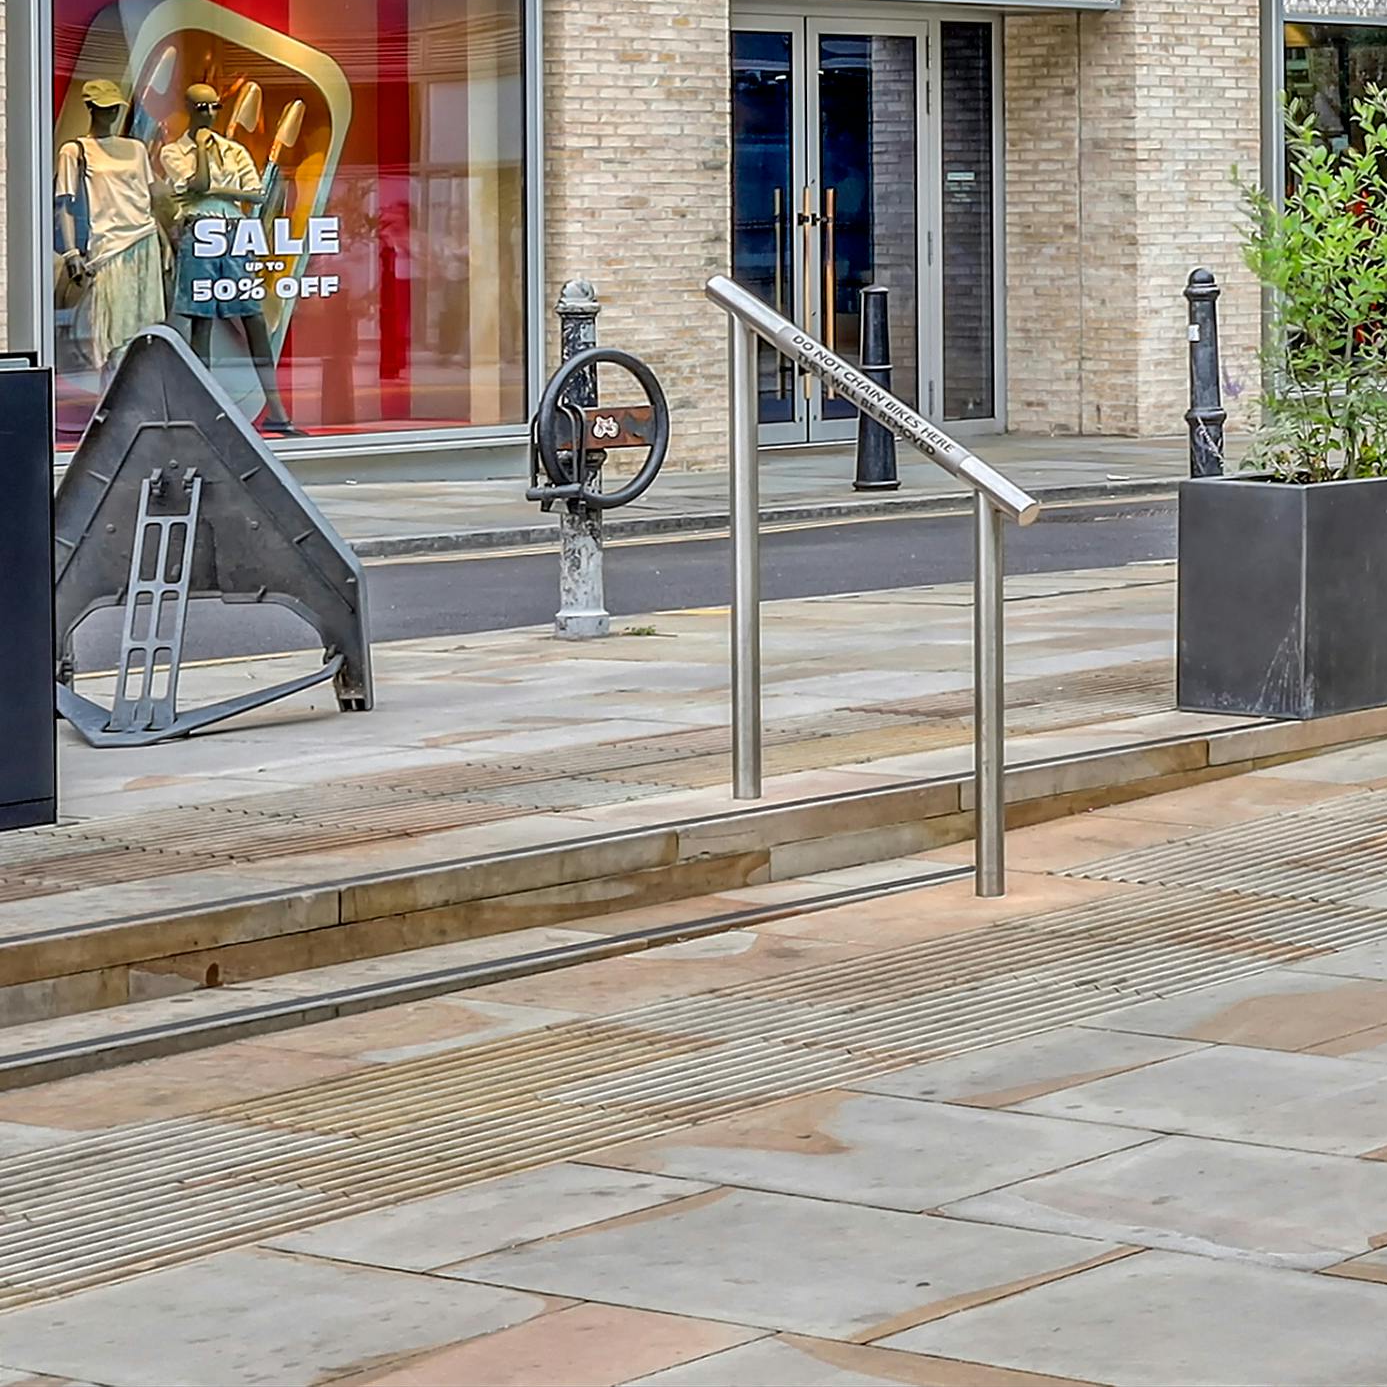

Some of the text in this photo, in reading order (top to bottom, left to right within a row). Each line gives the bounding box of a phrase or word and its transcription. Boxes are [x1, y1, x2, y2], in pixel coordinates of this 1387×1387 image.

[193, 217, 340, 258] SALE
[245, 261, 285, 272] UP TO
[192, 276, 339, 302] 50% OFF
[793, 334, 956, 454] DO NOT CHAIN BIKES HERE
[797, 351, 936, 457] THEY WILL BE REMOVED
